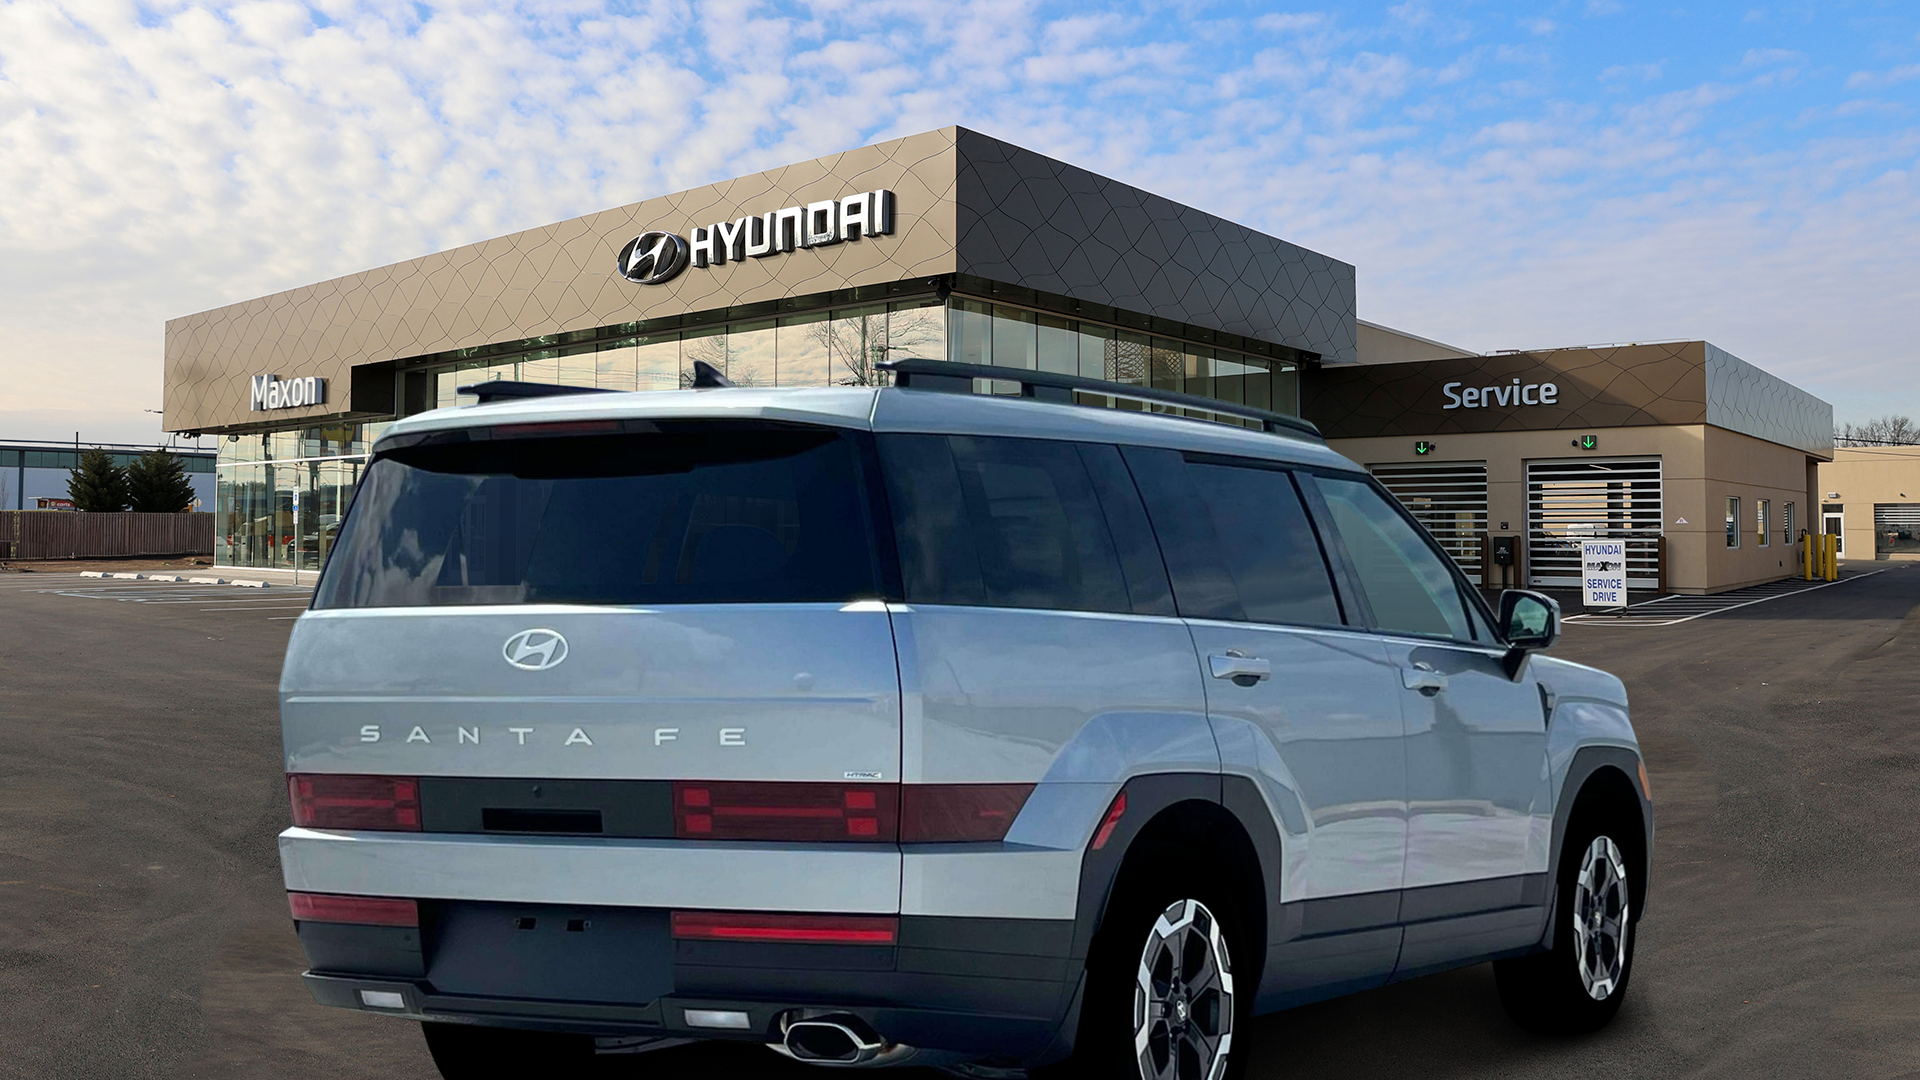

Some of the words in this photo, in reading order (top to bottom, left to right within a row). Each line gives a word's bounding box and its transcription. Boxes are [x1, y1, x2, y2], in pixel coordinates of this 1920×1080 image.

[690, 189, 889, 267] HYUNDAI
[250, 374, 320, 411] Maxon
[1443, 378, 1558, 409] Service
[1585, 544, 1622, 555] HYUNDAI
[1586, 561, 1622, 571] MAXON
[1587, 578, 1622, 589] SERVICE
[1592, 591, 1617, 602] DRIVE
[360, 724, 594, 746] SANTA
[653, 727, 746, 746] FE
